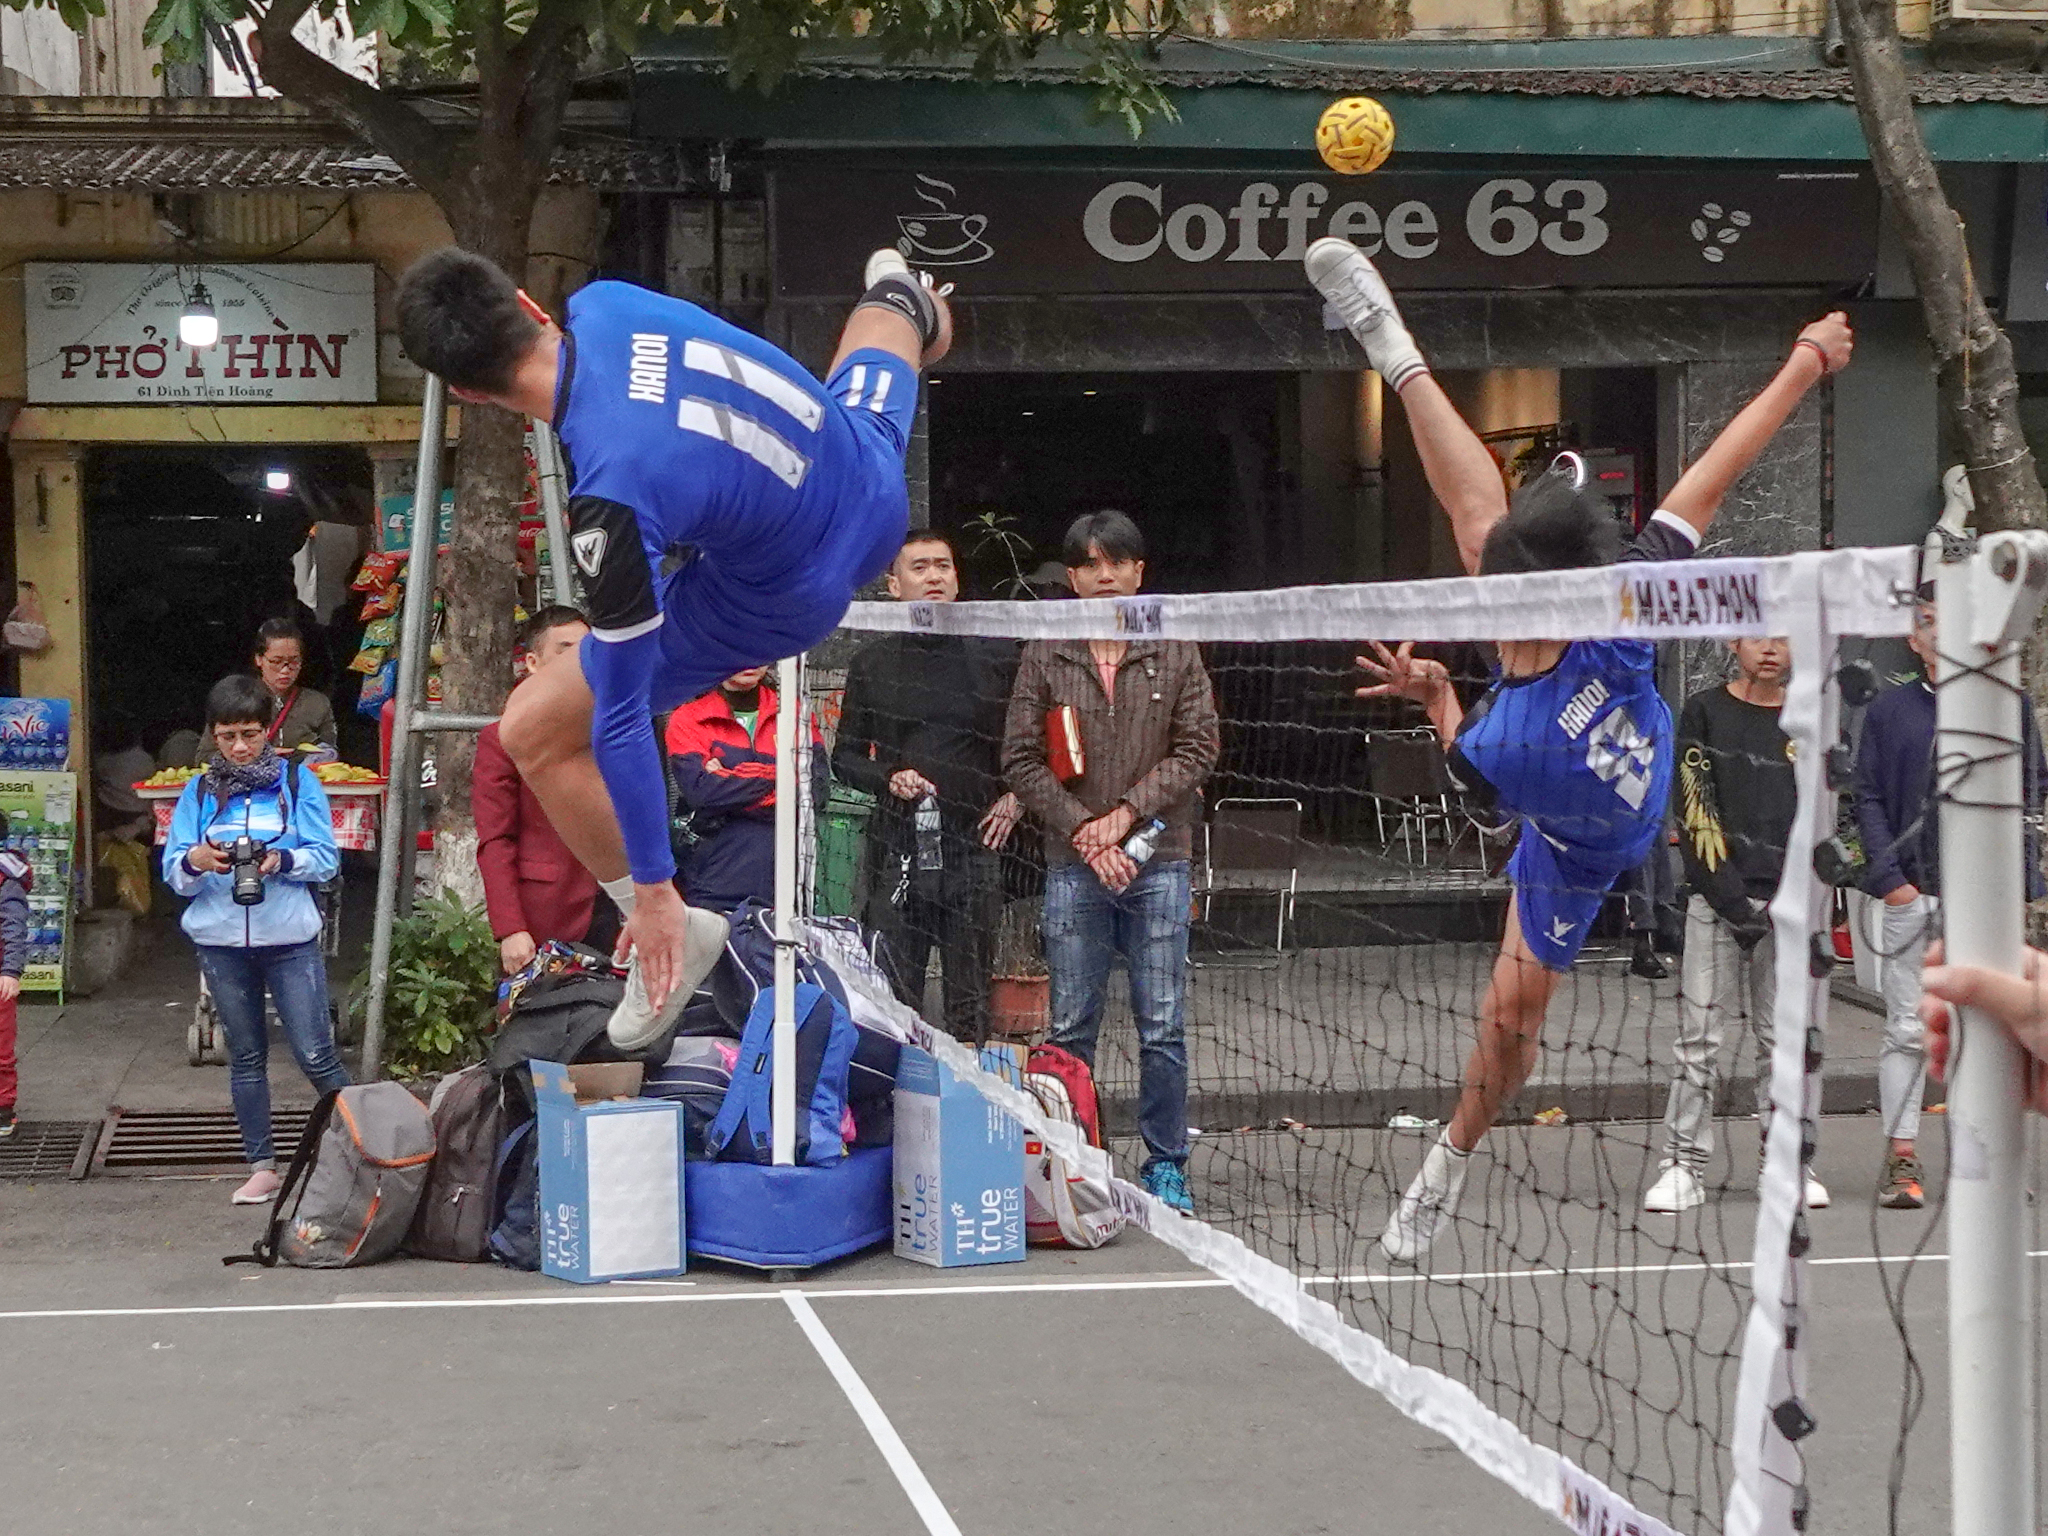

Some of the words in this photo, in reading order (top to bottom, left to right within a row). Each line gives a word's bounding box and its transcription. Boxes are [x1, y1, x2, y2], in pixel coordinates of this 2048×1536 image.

[1083, 181, 1438, 262] Coffee
[1466, 179, 1609, 256] 63
[60, 325, 167, 379] PHỞ
[176, 316, 349, 379] THÌN
[628, 333, 669, 403] HANOI
[137, 386, 151, 397] 61
[845, 364, 894, 413] 11
[1634, 572, 1761, 627] MARATHON
[1557, 678, 1611, 741] HANOI
[557, 1203, 571, 1267] true
[570, 1205, 581, 1270] WATER
[912, 1174, 927, 1250] true
[928, 1175, 939, 1252] WATER
[957, 1219, 976, 1256] TH
[976, 1189, 1003, 1256] true
[1004, 1188, 1019, 1251] WATER
